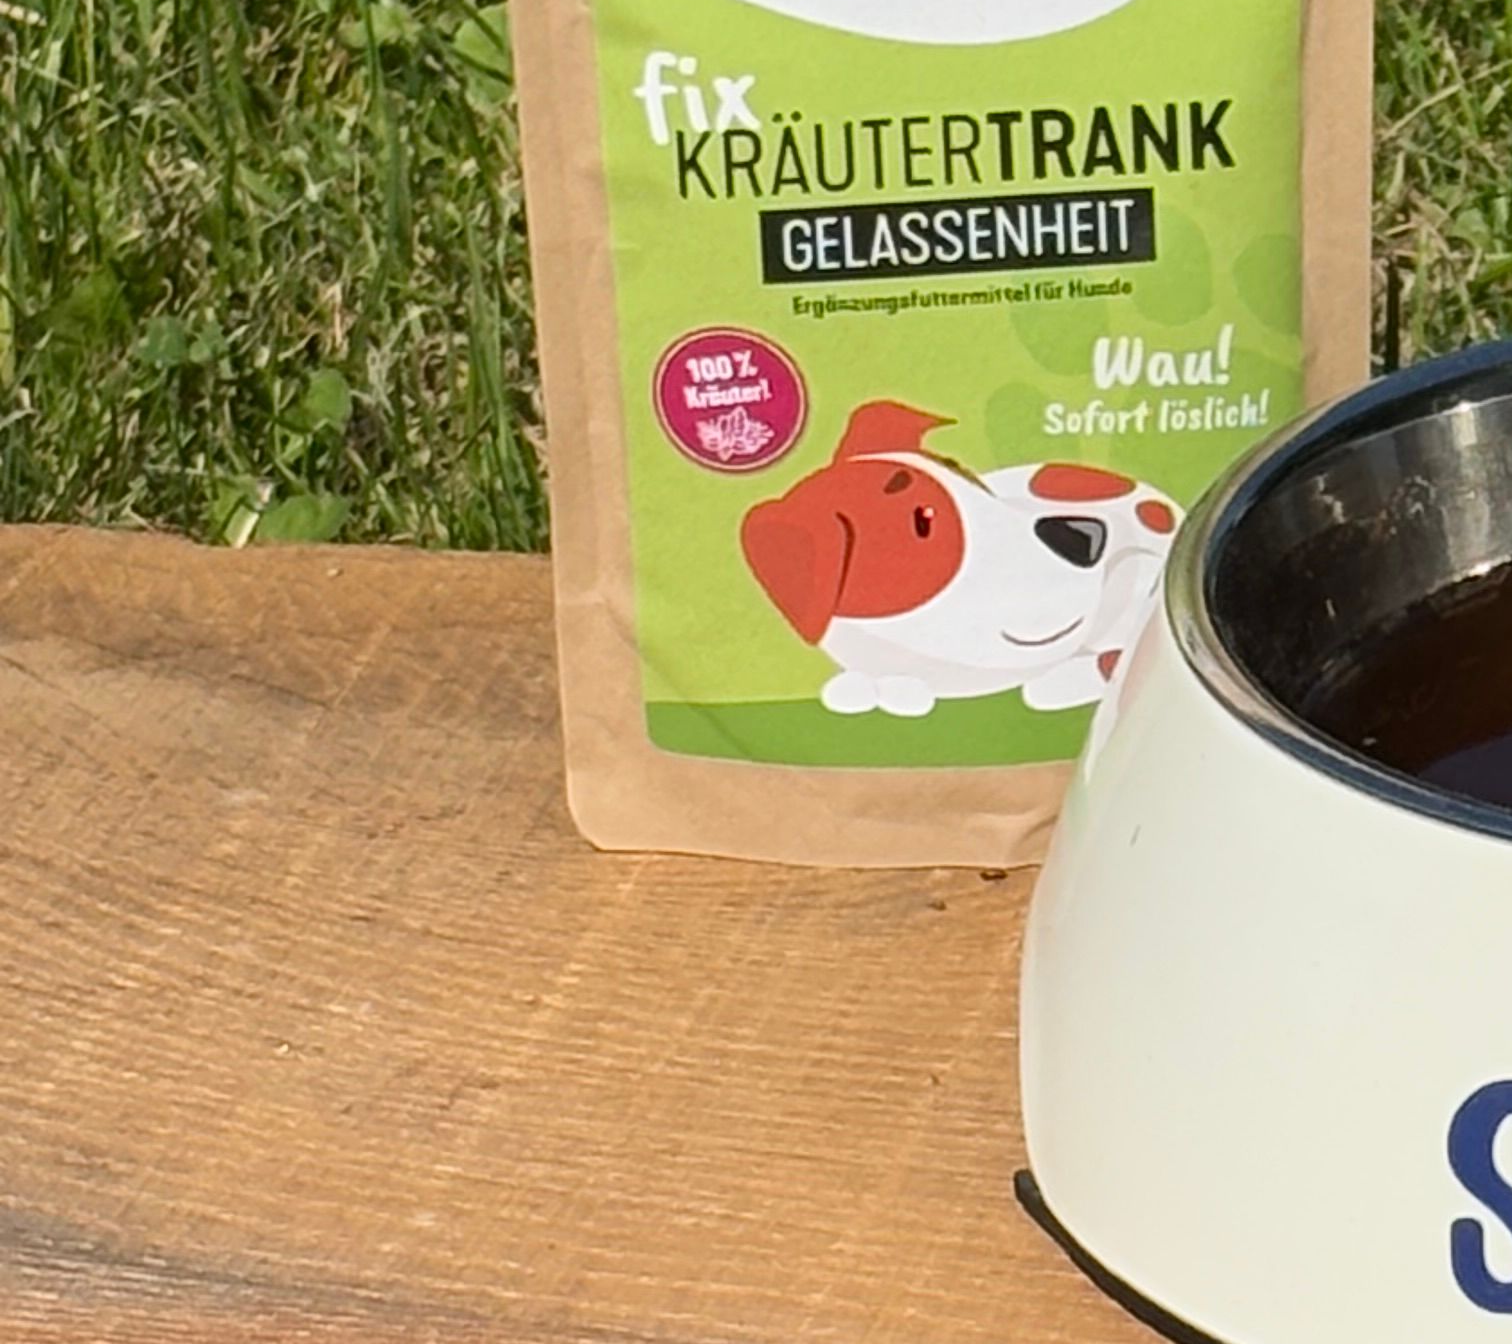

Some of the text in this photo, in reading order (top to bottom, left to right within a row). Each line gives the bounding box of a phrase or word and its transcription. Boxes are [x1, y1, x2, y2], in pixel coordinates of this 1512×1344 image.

[634, 51, 761, 146] fix
[676, 99, 1236, 201] KRÄUTERTRANK
[781, 199, 1135, 272] GELASSENHEIT
[792, 277, 1133, 318] Ergänzungsfuttermittel für Hunde
[1092, 324, 1234, 388] Wau!
[683, 378, 773, 409] Kräuter!
[1043, 389, 1269, 435] Sofort löslich!
